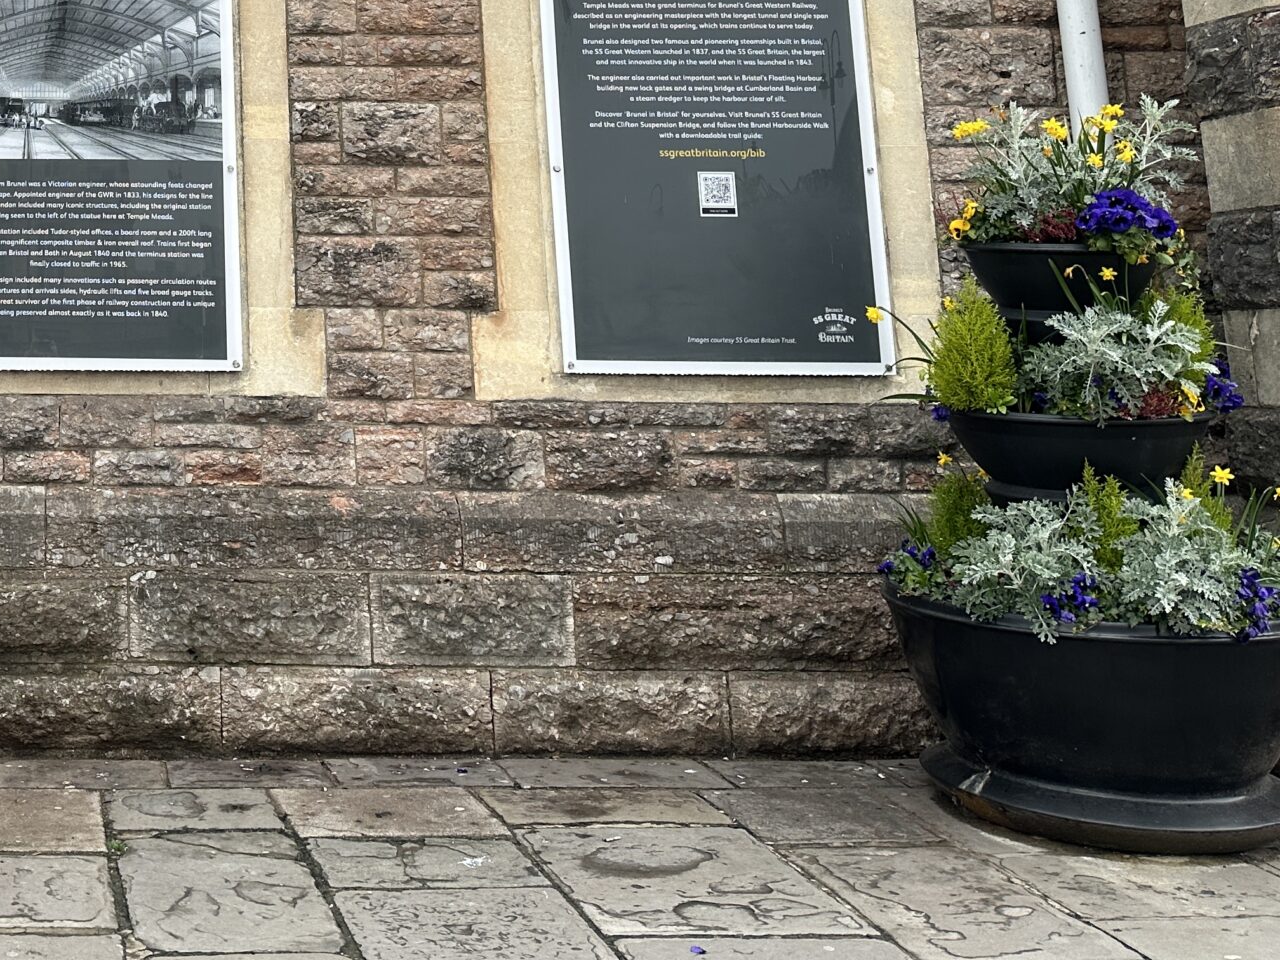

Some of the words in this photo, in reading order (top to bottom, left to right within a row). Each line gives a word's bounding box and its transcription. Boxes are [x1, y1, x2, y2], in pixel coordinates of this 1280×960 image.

[584, 2, 607, 10] Temple
[657, 2, 677, 10] grand
[792, 2, 818, 10] Railway,
[624, 12, 663, 20] engineering
[664, 12, 704, 20] masterpiece
[733, 13, 757, 21] longest
[794, 13, 812, 21] single
[601, 75, 630, 83] engineer
[683, 75, 716, 83] important
[769, 75, 795, 83] Floating
[640, 122, 678, 130] Suspension
[679, 122, 702, 130] Bridge,
[659, 148, 766, 160] ssgreatbritain.org/bib
[78, 181, 108, 190] engineer,
[130, 182, 167, 190] astounding
[185, 182, 213, 190] changed
[120, 202, 150, 211] including
[163, 203, 188, 211] original
[30, 260, 50, 269] finally
[79, 288, 109, 296] hydraulic
[812, 315, 824, 324] SS
[824, 313, 856, 324] GREAT
[818, 332, 854, 342] BRITAIN
